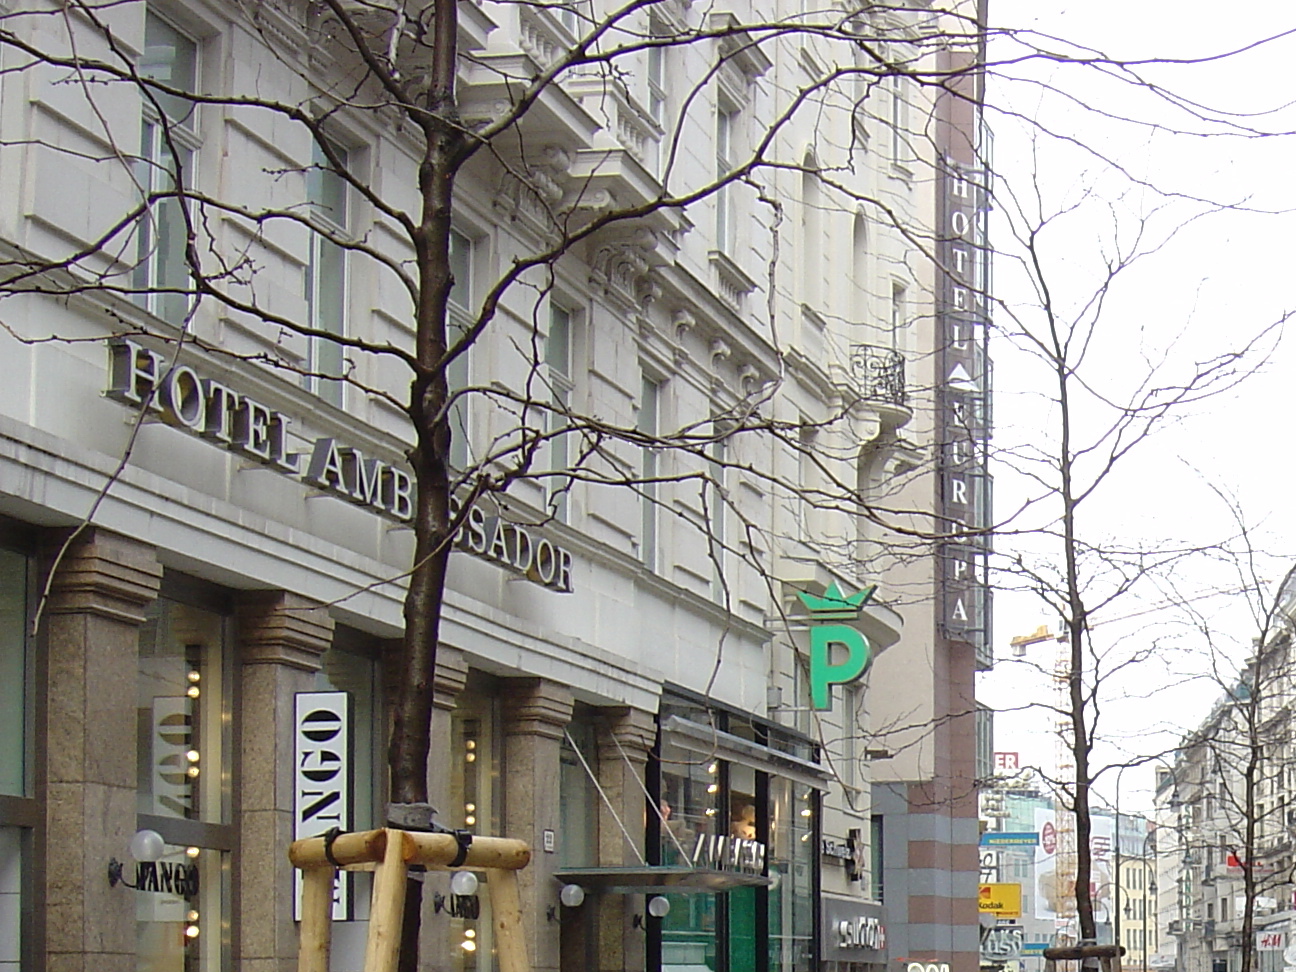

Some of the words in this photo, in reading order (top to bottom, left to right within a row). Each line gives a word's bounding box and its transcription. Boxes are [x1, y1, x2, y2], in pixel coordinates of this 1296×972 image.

[951, 174, 970, 351] HOTEL
[103, 338, 301, 473] HOTEL
[304, 437, 575, 594] AMBSADOR
[810, 624, 873, 710] P
[1260, 934, 1282, 948] H&M
